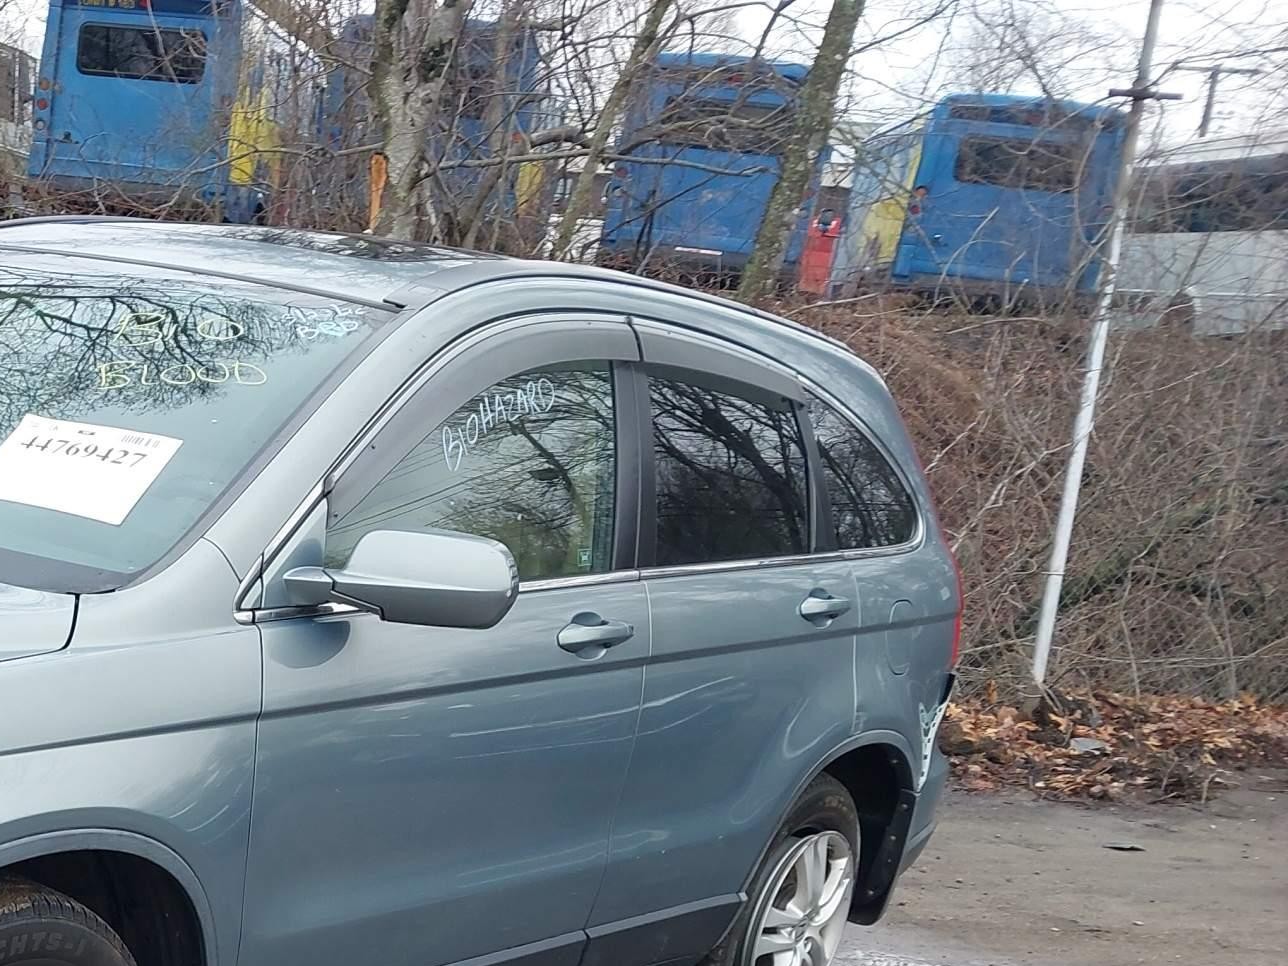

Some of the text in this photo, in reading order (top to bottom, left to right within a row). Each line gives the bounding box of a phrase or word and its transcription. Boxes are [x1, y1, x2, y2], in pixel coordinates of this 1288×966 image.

[97, 352, 268, 390] BLOOD
[442, 378, 555, 471] BIOHAZARD
[21, 436, 148, 467] 44769427
